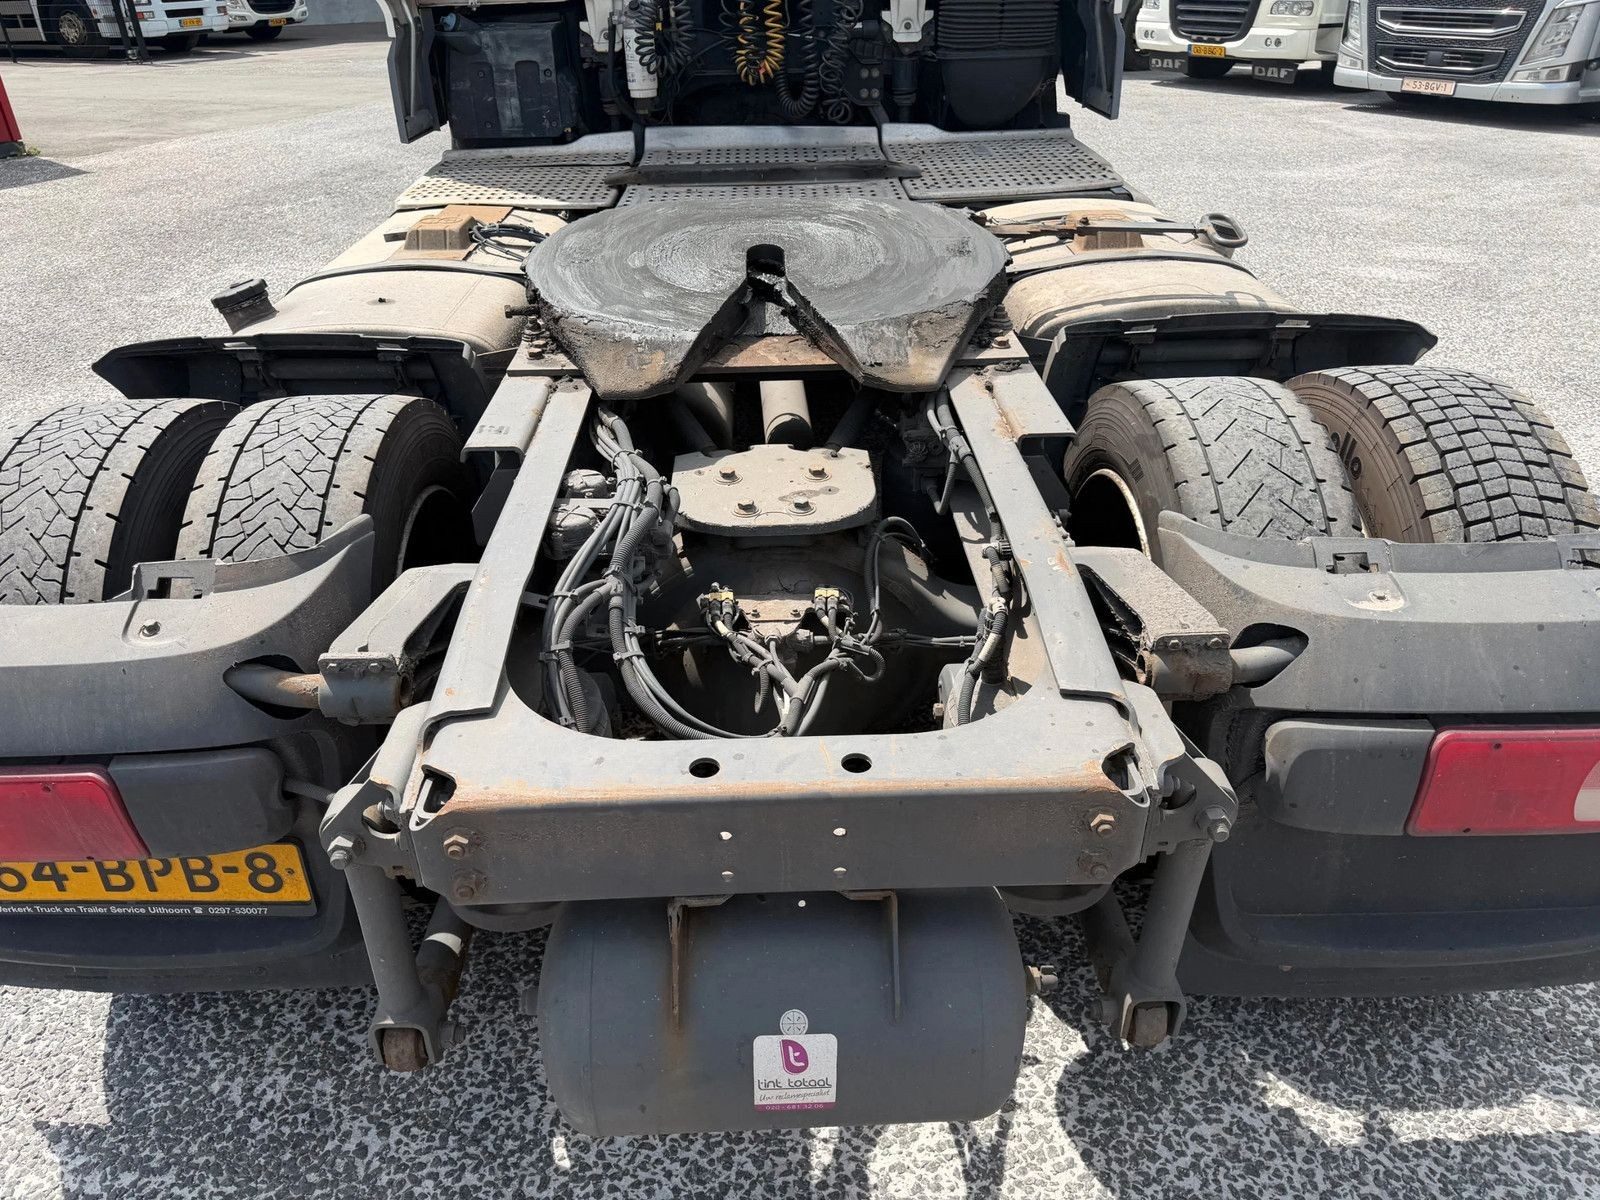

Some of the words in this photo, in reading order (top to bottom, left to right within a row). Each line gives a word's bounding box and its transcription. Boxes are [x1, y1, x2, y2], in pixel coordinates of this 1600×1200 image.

[1151, 58, 1186, 69] DAF
[1254, 66, 1294, 78] DAF
[34, 905, 62, 914] Truck
[64, 906, 77, 914] en
[77, 905, 108, 914] Trailer
[110, 905, 146, 914] Service
[147, 905, 191, 914] Uithoorn
[208, 906, 268, 915] 0297-530077
[757, 1078, 782, 1089] tint
[788, 1077, 832, 1088] totaal
